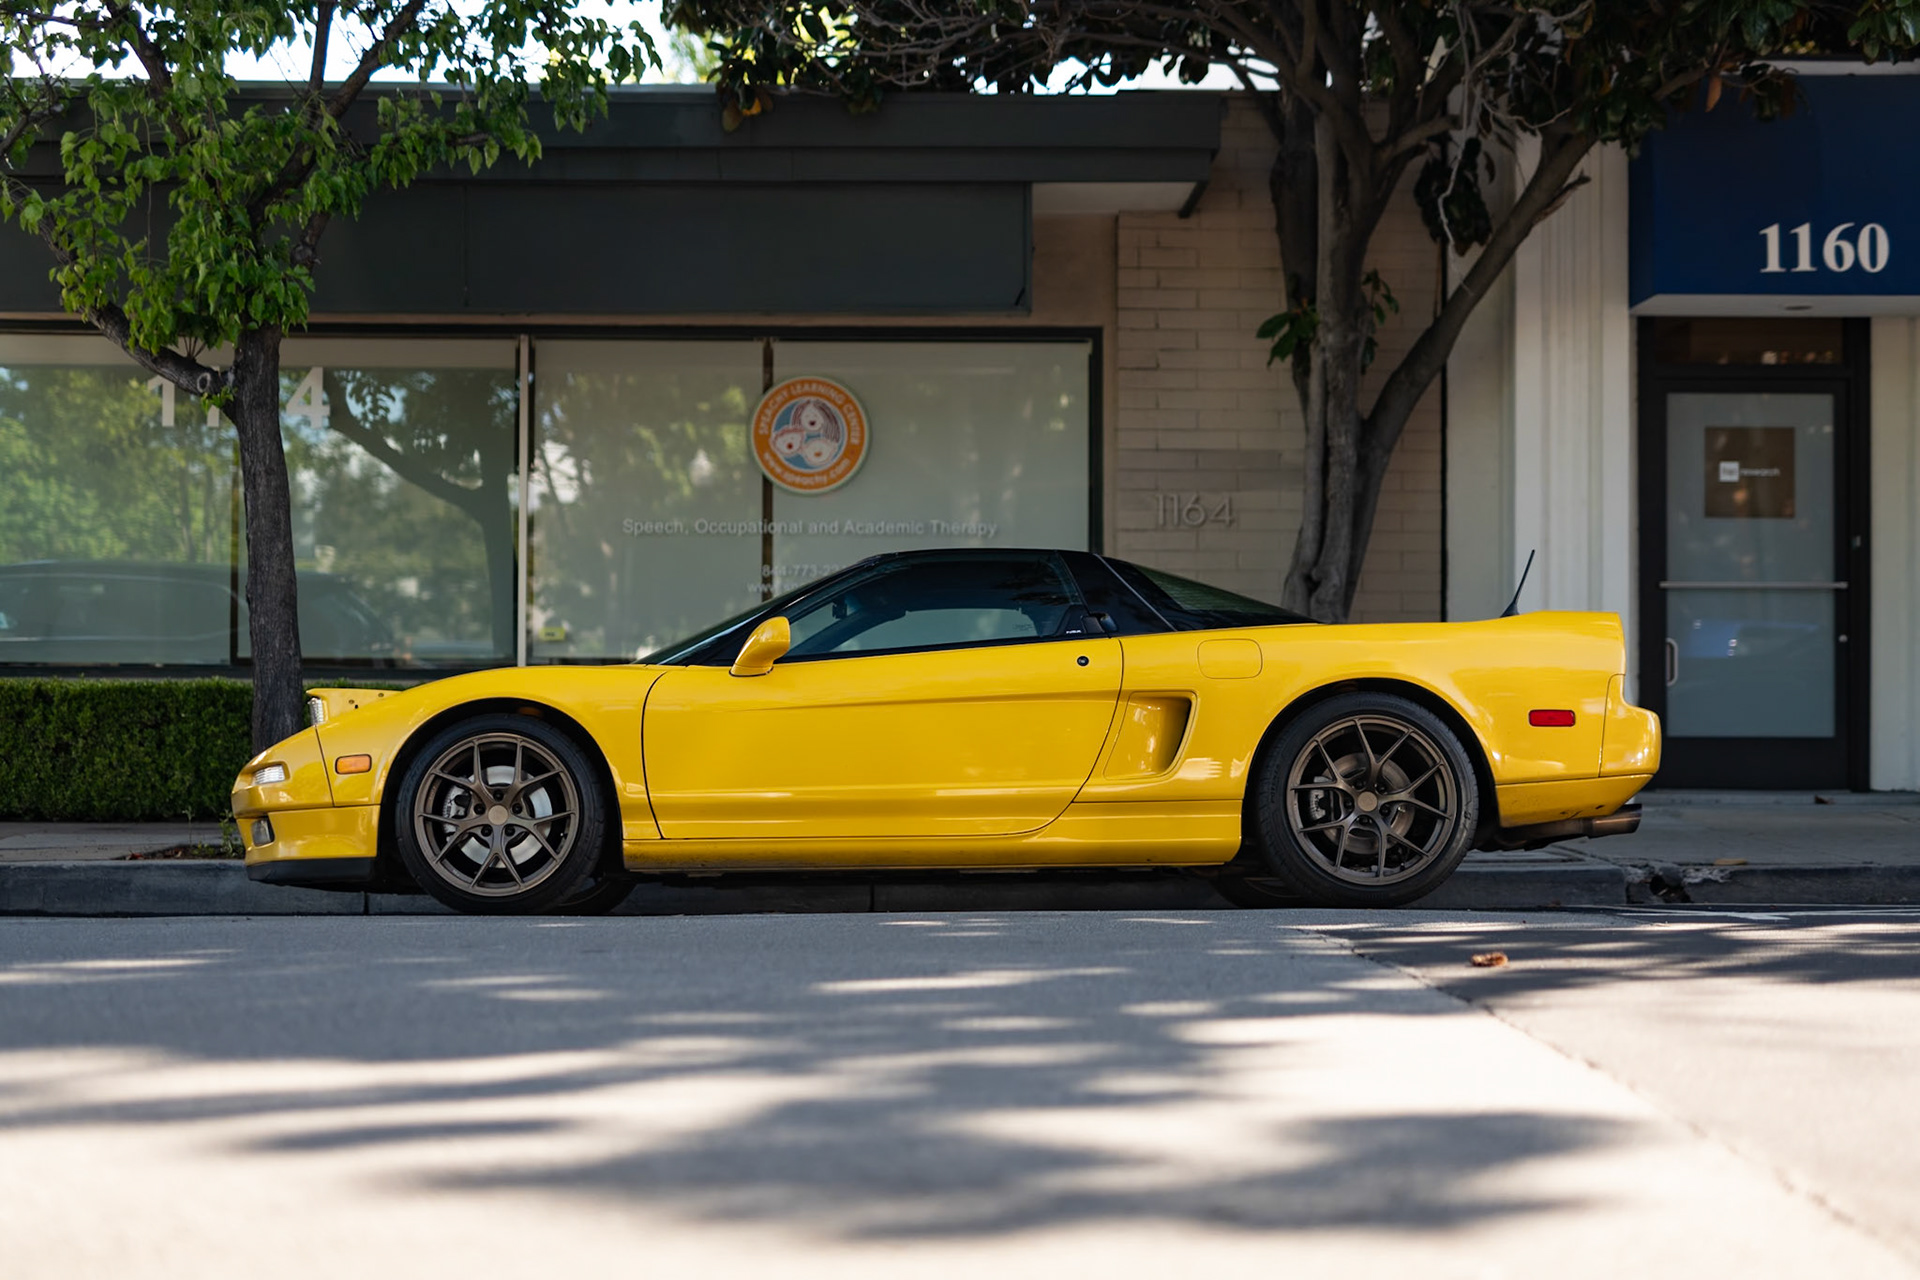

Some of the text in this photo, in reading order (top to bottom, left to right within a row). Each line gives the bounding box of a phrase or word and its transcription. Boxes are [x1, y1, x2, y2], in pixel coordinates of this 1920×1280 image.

[1758, 222, 1890, 273] 1160
[790, 382, 846, 404] LEARNING
[843, 403, 860, 445] CENTER
[622, 518, 998, 538] Speech, Occupational and Academic Therapy
[1154, 492, 1235, 527] 1164
